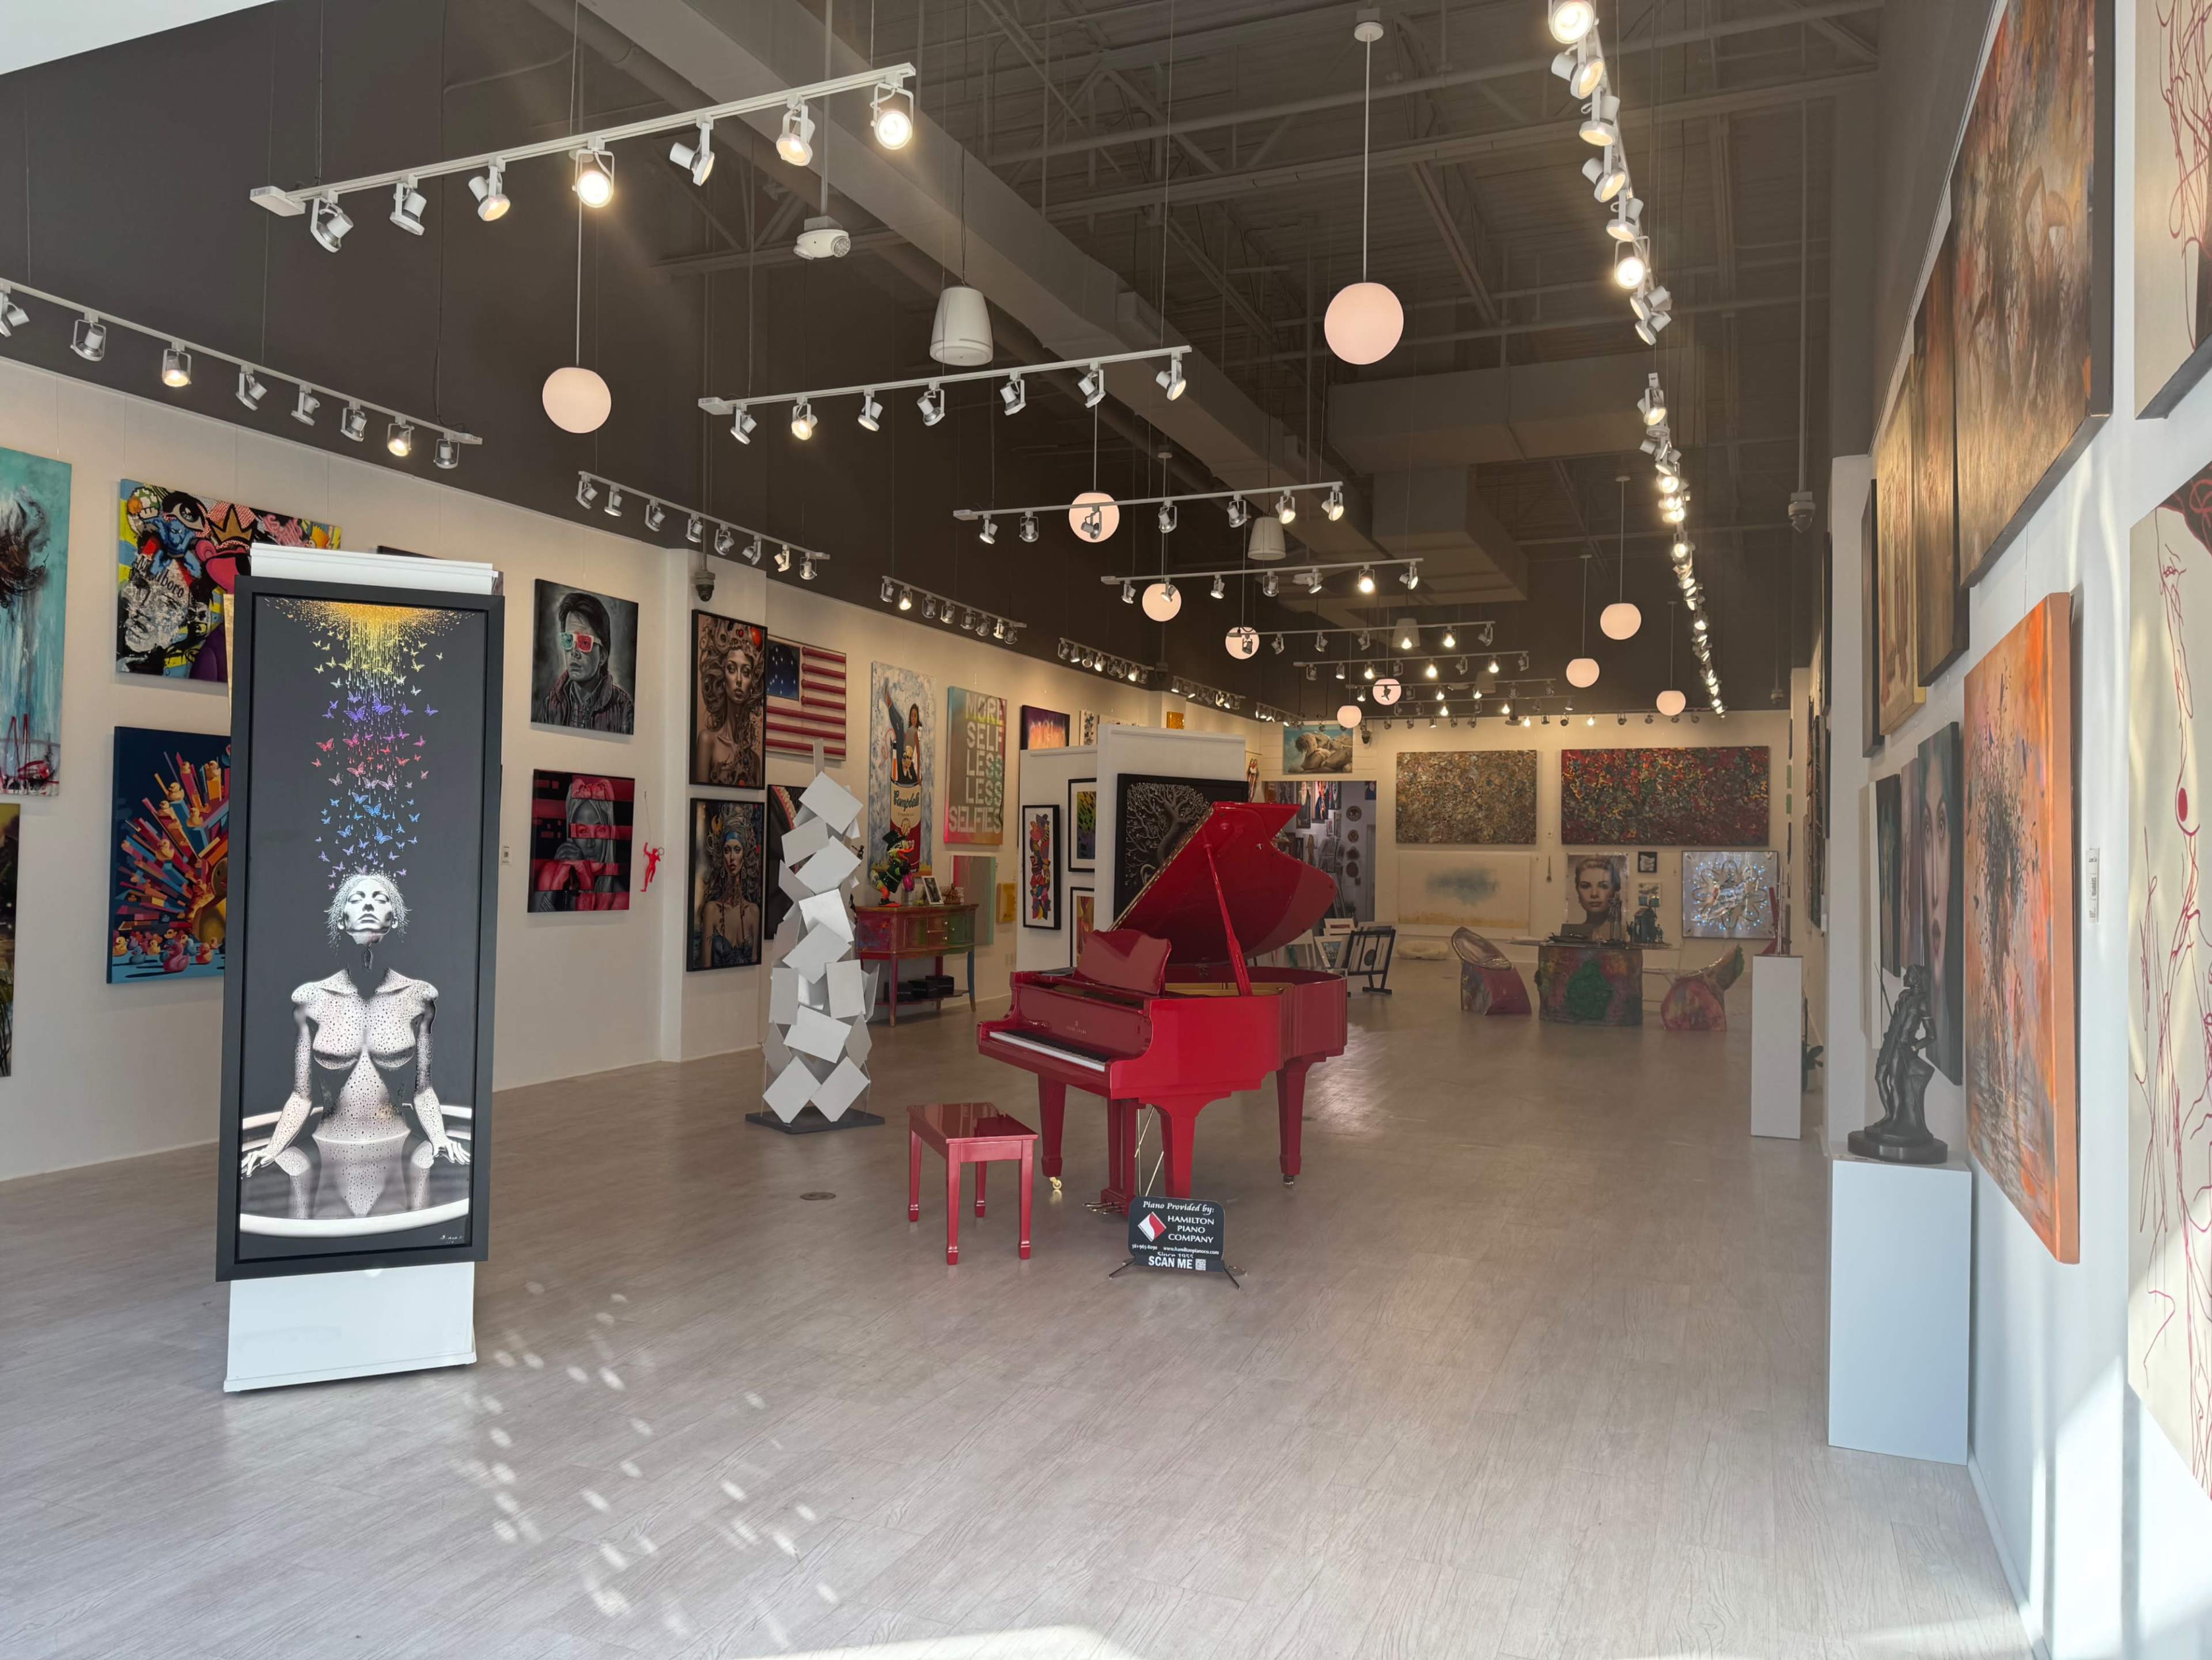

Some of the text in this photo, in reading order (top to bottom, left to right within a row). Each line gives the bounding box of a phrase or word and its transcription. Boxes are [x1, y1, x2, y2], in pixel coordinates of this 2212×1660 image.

[965, 691, 1004, 725] MORE
[967, 721, 1003, 752] SELF
[967, 749, 1002, 780] LESS
[965, 777, 1002, 806] LESS
[949, 806, 1002, 834] SELFIES
[1143, 1201, 1214, 1216] Piano Provided by:
[1168, 1215, 1214, 1225] HAMILTON
[1177, 1225, 1206, 1234] PIANO
[1168, 1233, 1214, 1243] COMPANY
[1148, 1256, 1193, 1269] SCAN ME
